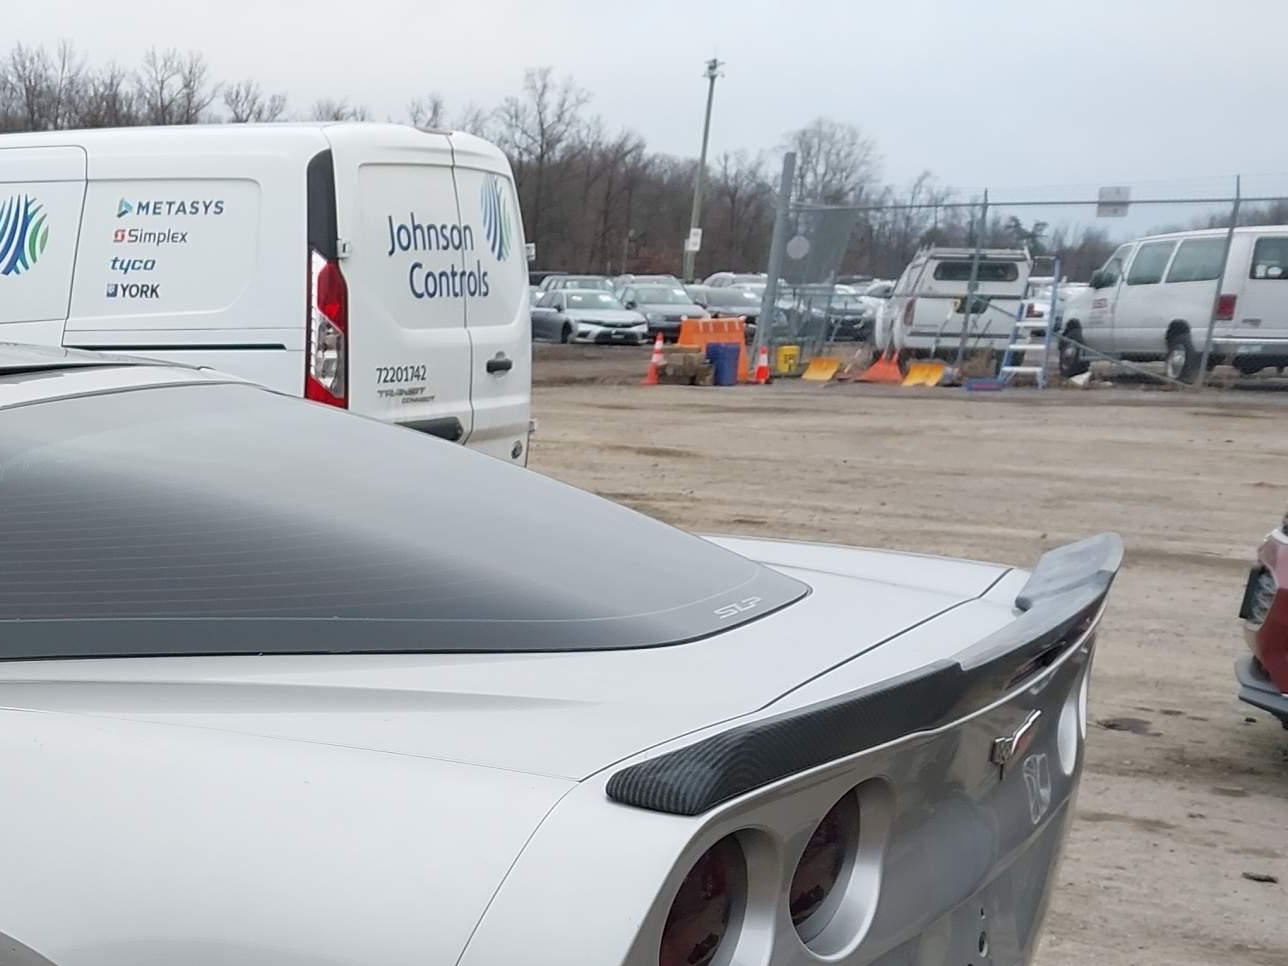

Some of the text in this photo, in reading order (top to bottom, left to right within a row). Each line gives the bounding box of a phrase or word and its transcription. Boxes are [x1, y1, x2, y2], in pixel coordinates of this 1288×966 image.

[136, 200, 225, 216] METASYS
[127, 228, 188, 246] Simplex
[388, 211, 474, 257] Johnson
[110, 256, 156, 274] tyco
[409, 259, 489, 299] Controls
[120, 283, 160, 298] YORK
[376, 364, 426, 384] 72201742
